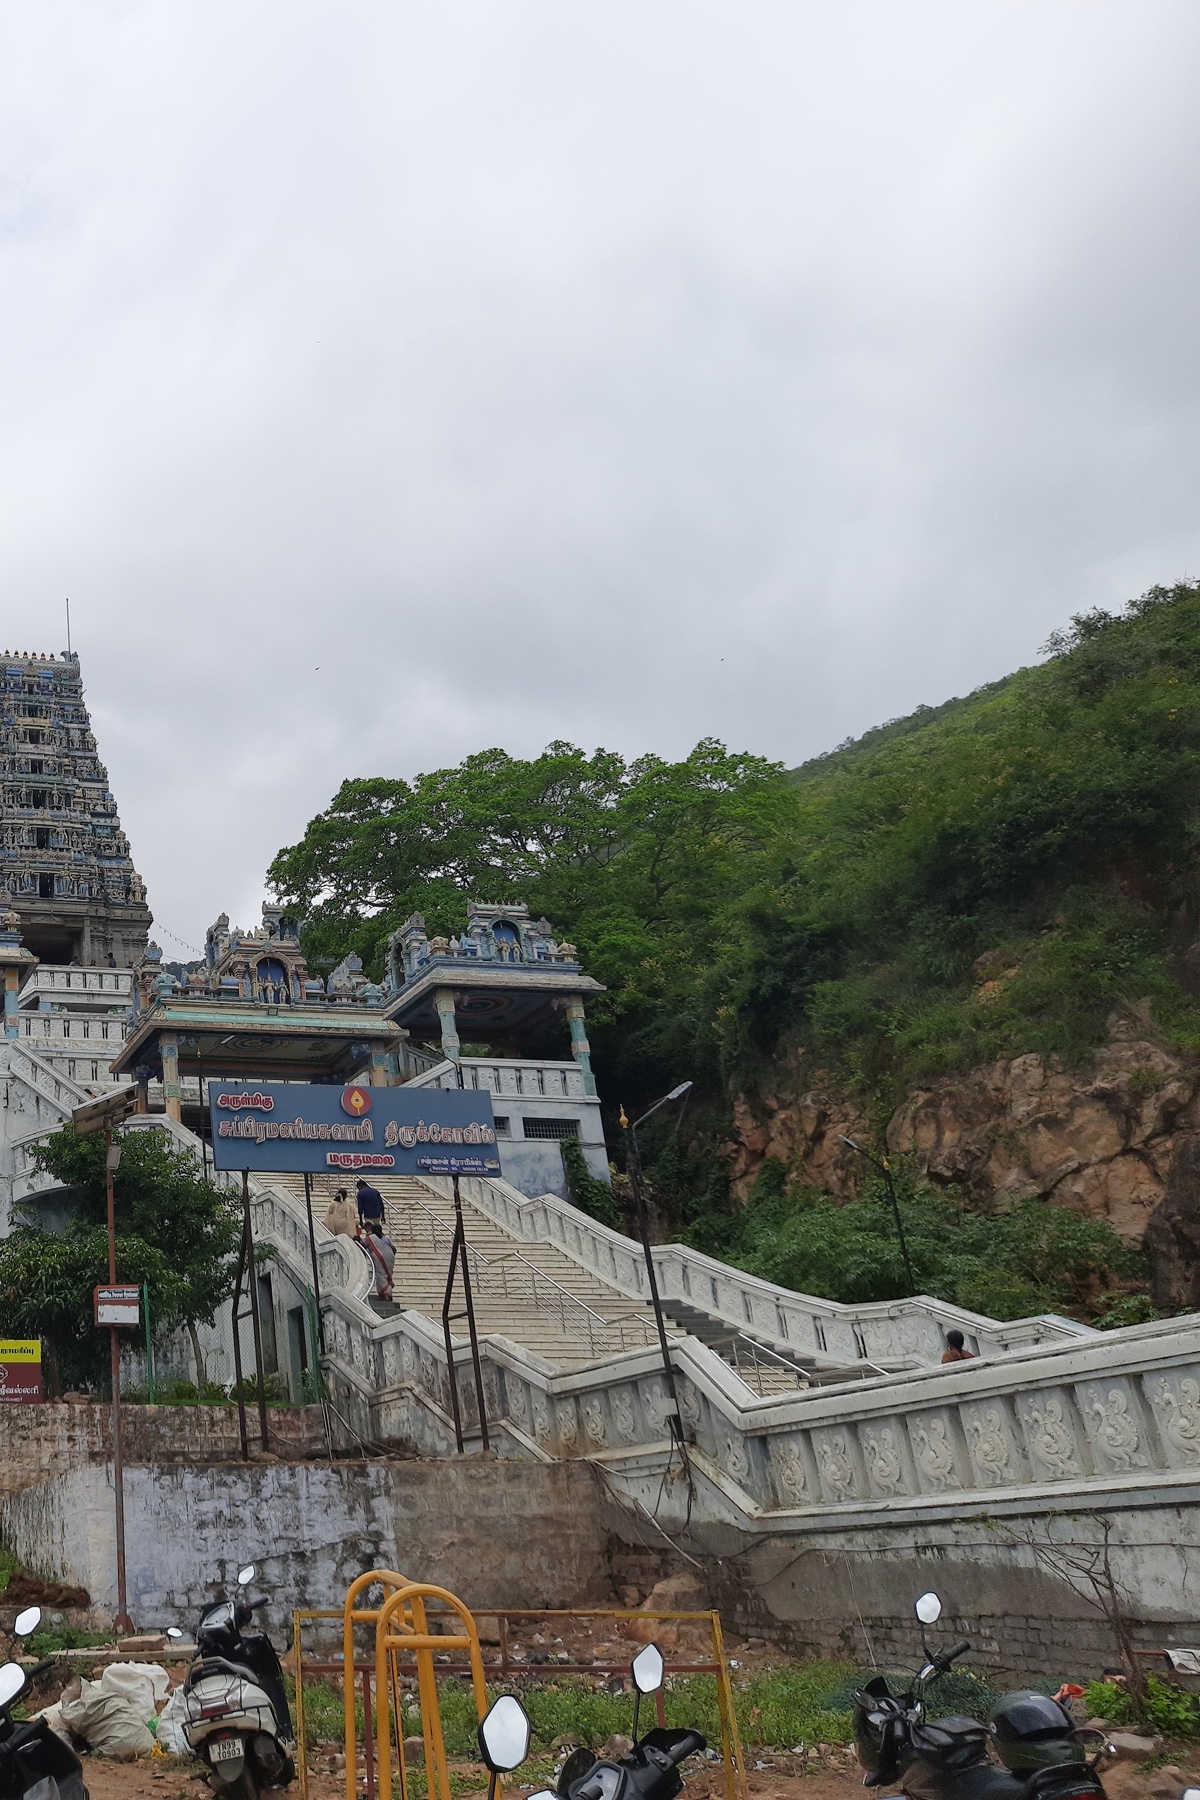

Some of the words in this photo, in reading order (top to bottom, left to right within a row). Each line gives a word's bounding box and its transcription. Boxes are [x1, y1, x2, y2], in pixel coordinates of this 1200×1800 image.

[218, 1092, 274, 1111] அருள்மிகு
[219, 1116, 374, 1144] சுப்பிரமணியசுவாமி
[327, 1153, 395, 1169] மருதமலை
